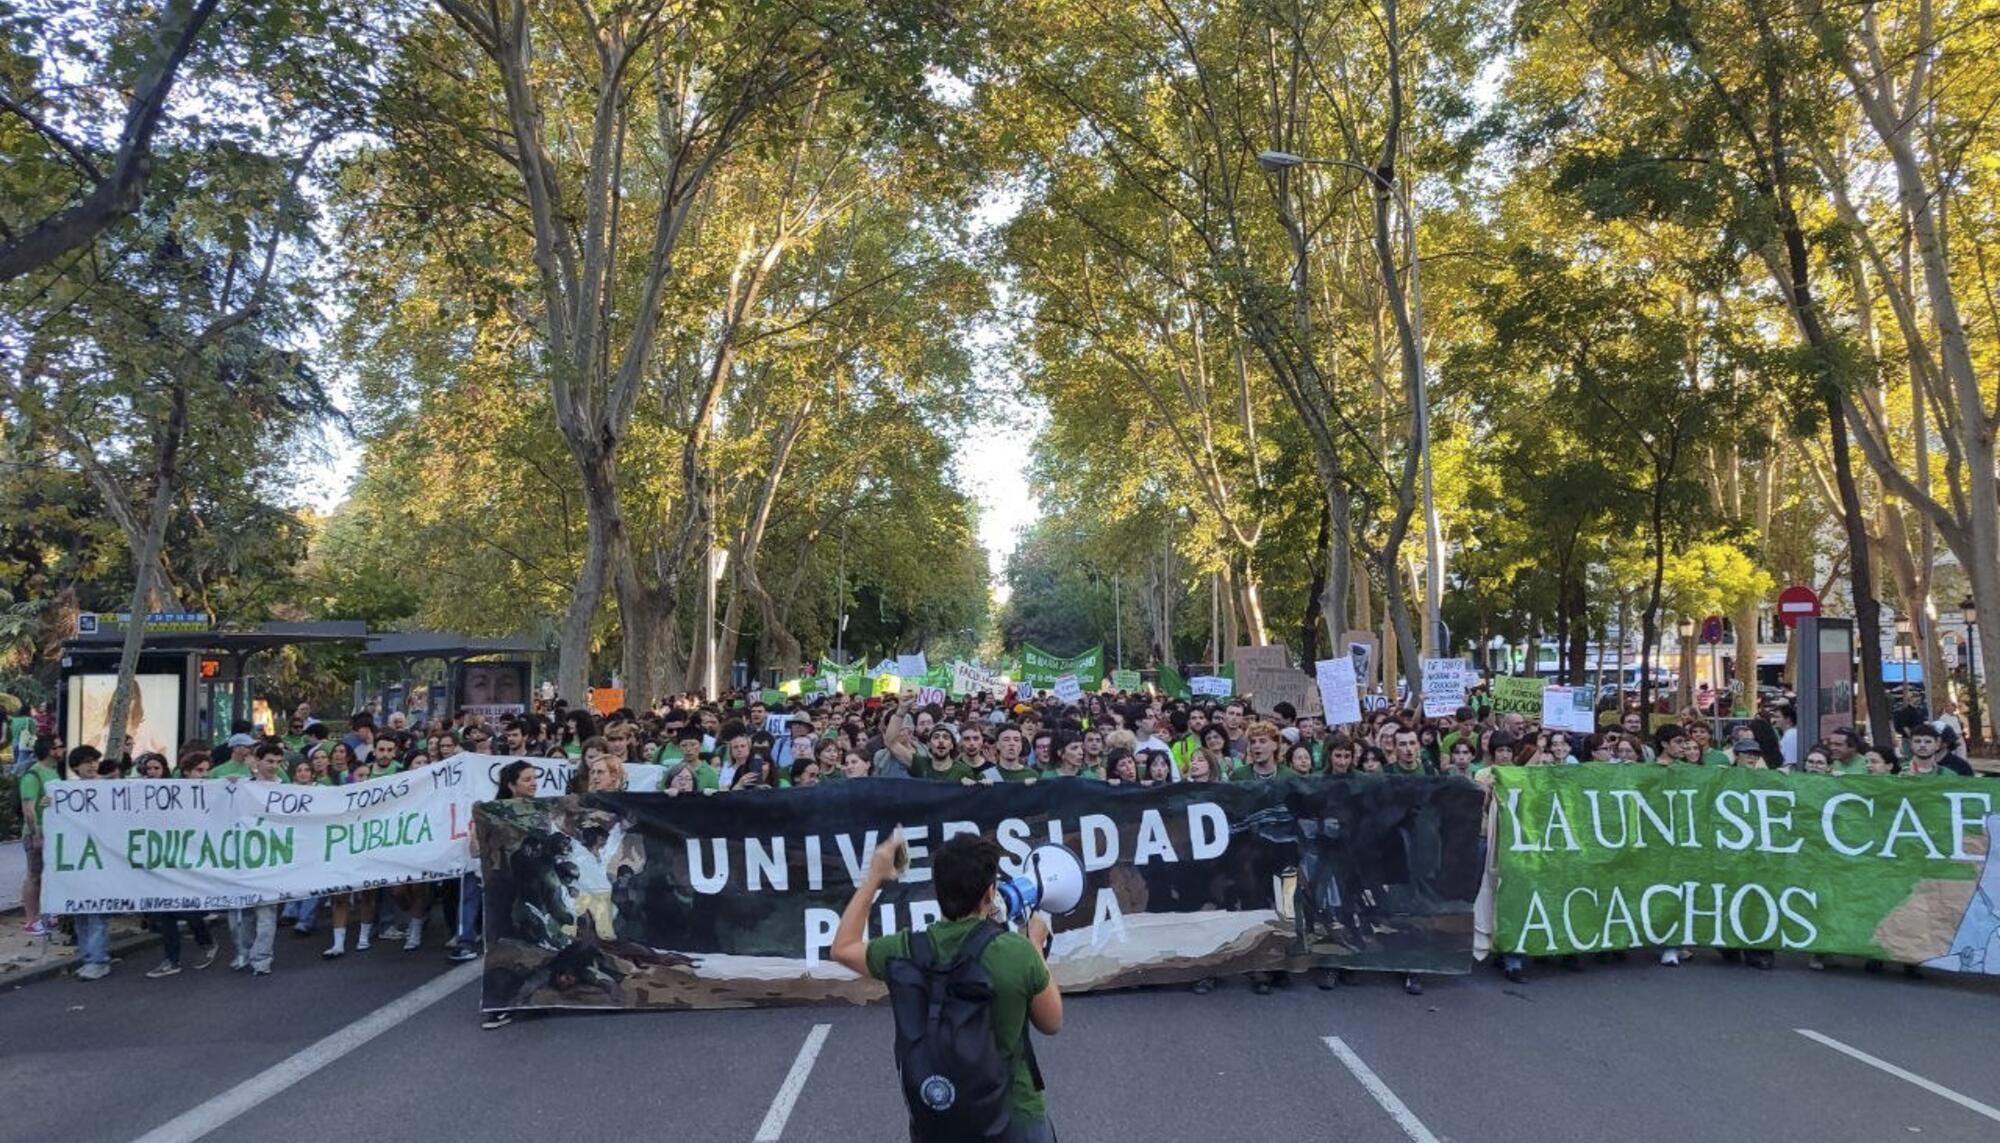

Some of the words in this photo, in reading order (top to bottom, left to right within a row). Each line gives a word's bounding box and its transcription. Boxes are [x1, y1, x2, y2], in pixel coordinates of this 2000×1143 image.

[1365, 696, 1388, 711] NO
[54, 788, 99, 814] POR
[144, 785, 183, 811] POR
[225, 786, 237, 808] Y
[265, 790, 314, 814] POR
[345, 779, 410, 812] TODAS
[432, 761, 464, 790] MIS
[56, 833, 103, 872] LA
[126, 817, 294, 870] EDUCACIÓN
[324, 812, 433, 862] PÚBLICA
[685, 801, 1230, 895] UNIVESDAD
[1714, 789, 1805, 853] SE
[1821, 792, 1992, 860] CAE
[65, 898, 136, 912] PLATAFORMA
